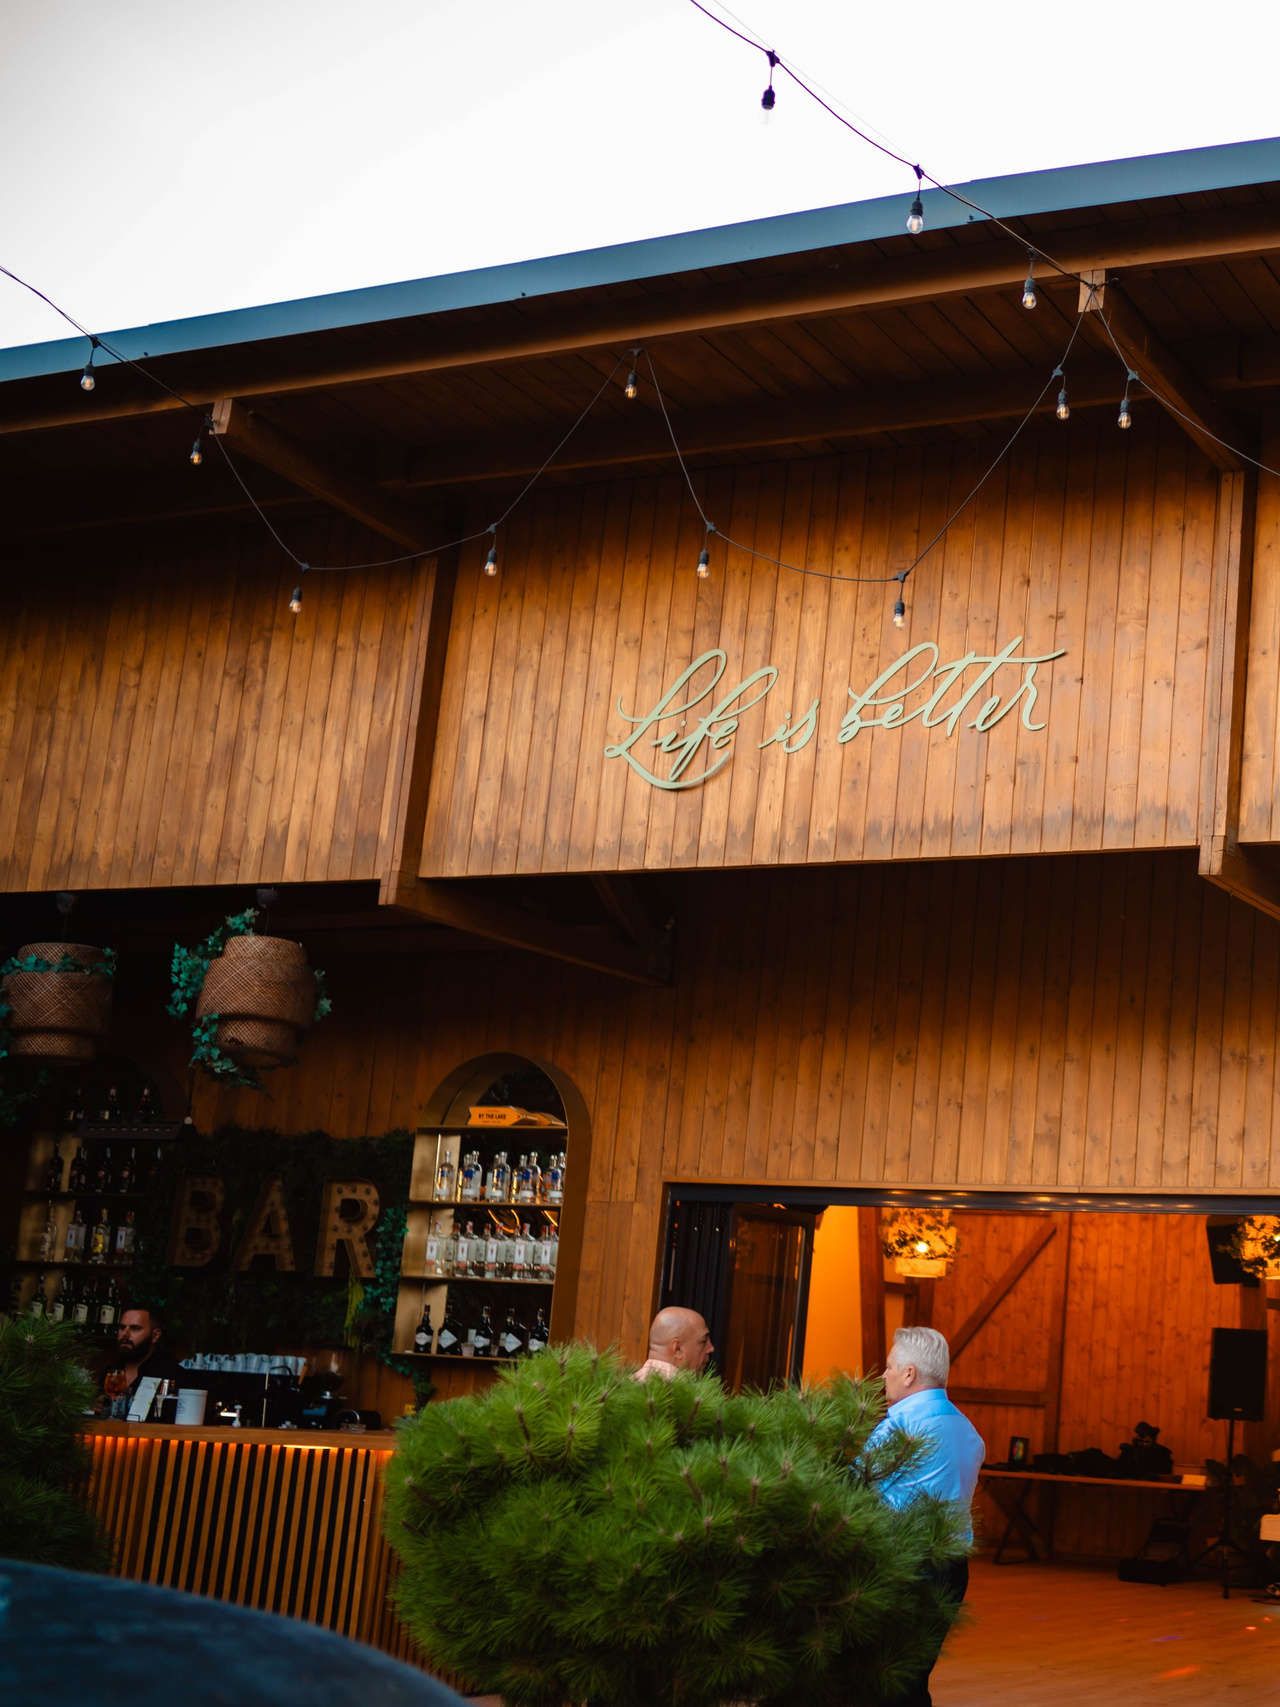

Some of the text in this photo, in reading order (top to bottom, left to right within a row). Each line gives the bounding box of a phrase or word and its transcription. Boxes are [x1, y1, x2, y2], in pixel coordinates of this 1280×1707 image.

[604, 635, 1066, 790] Life is better
[166, 1171, 380, 1278] BAR
